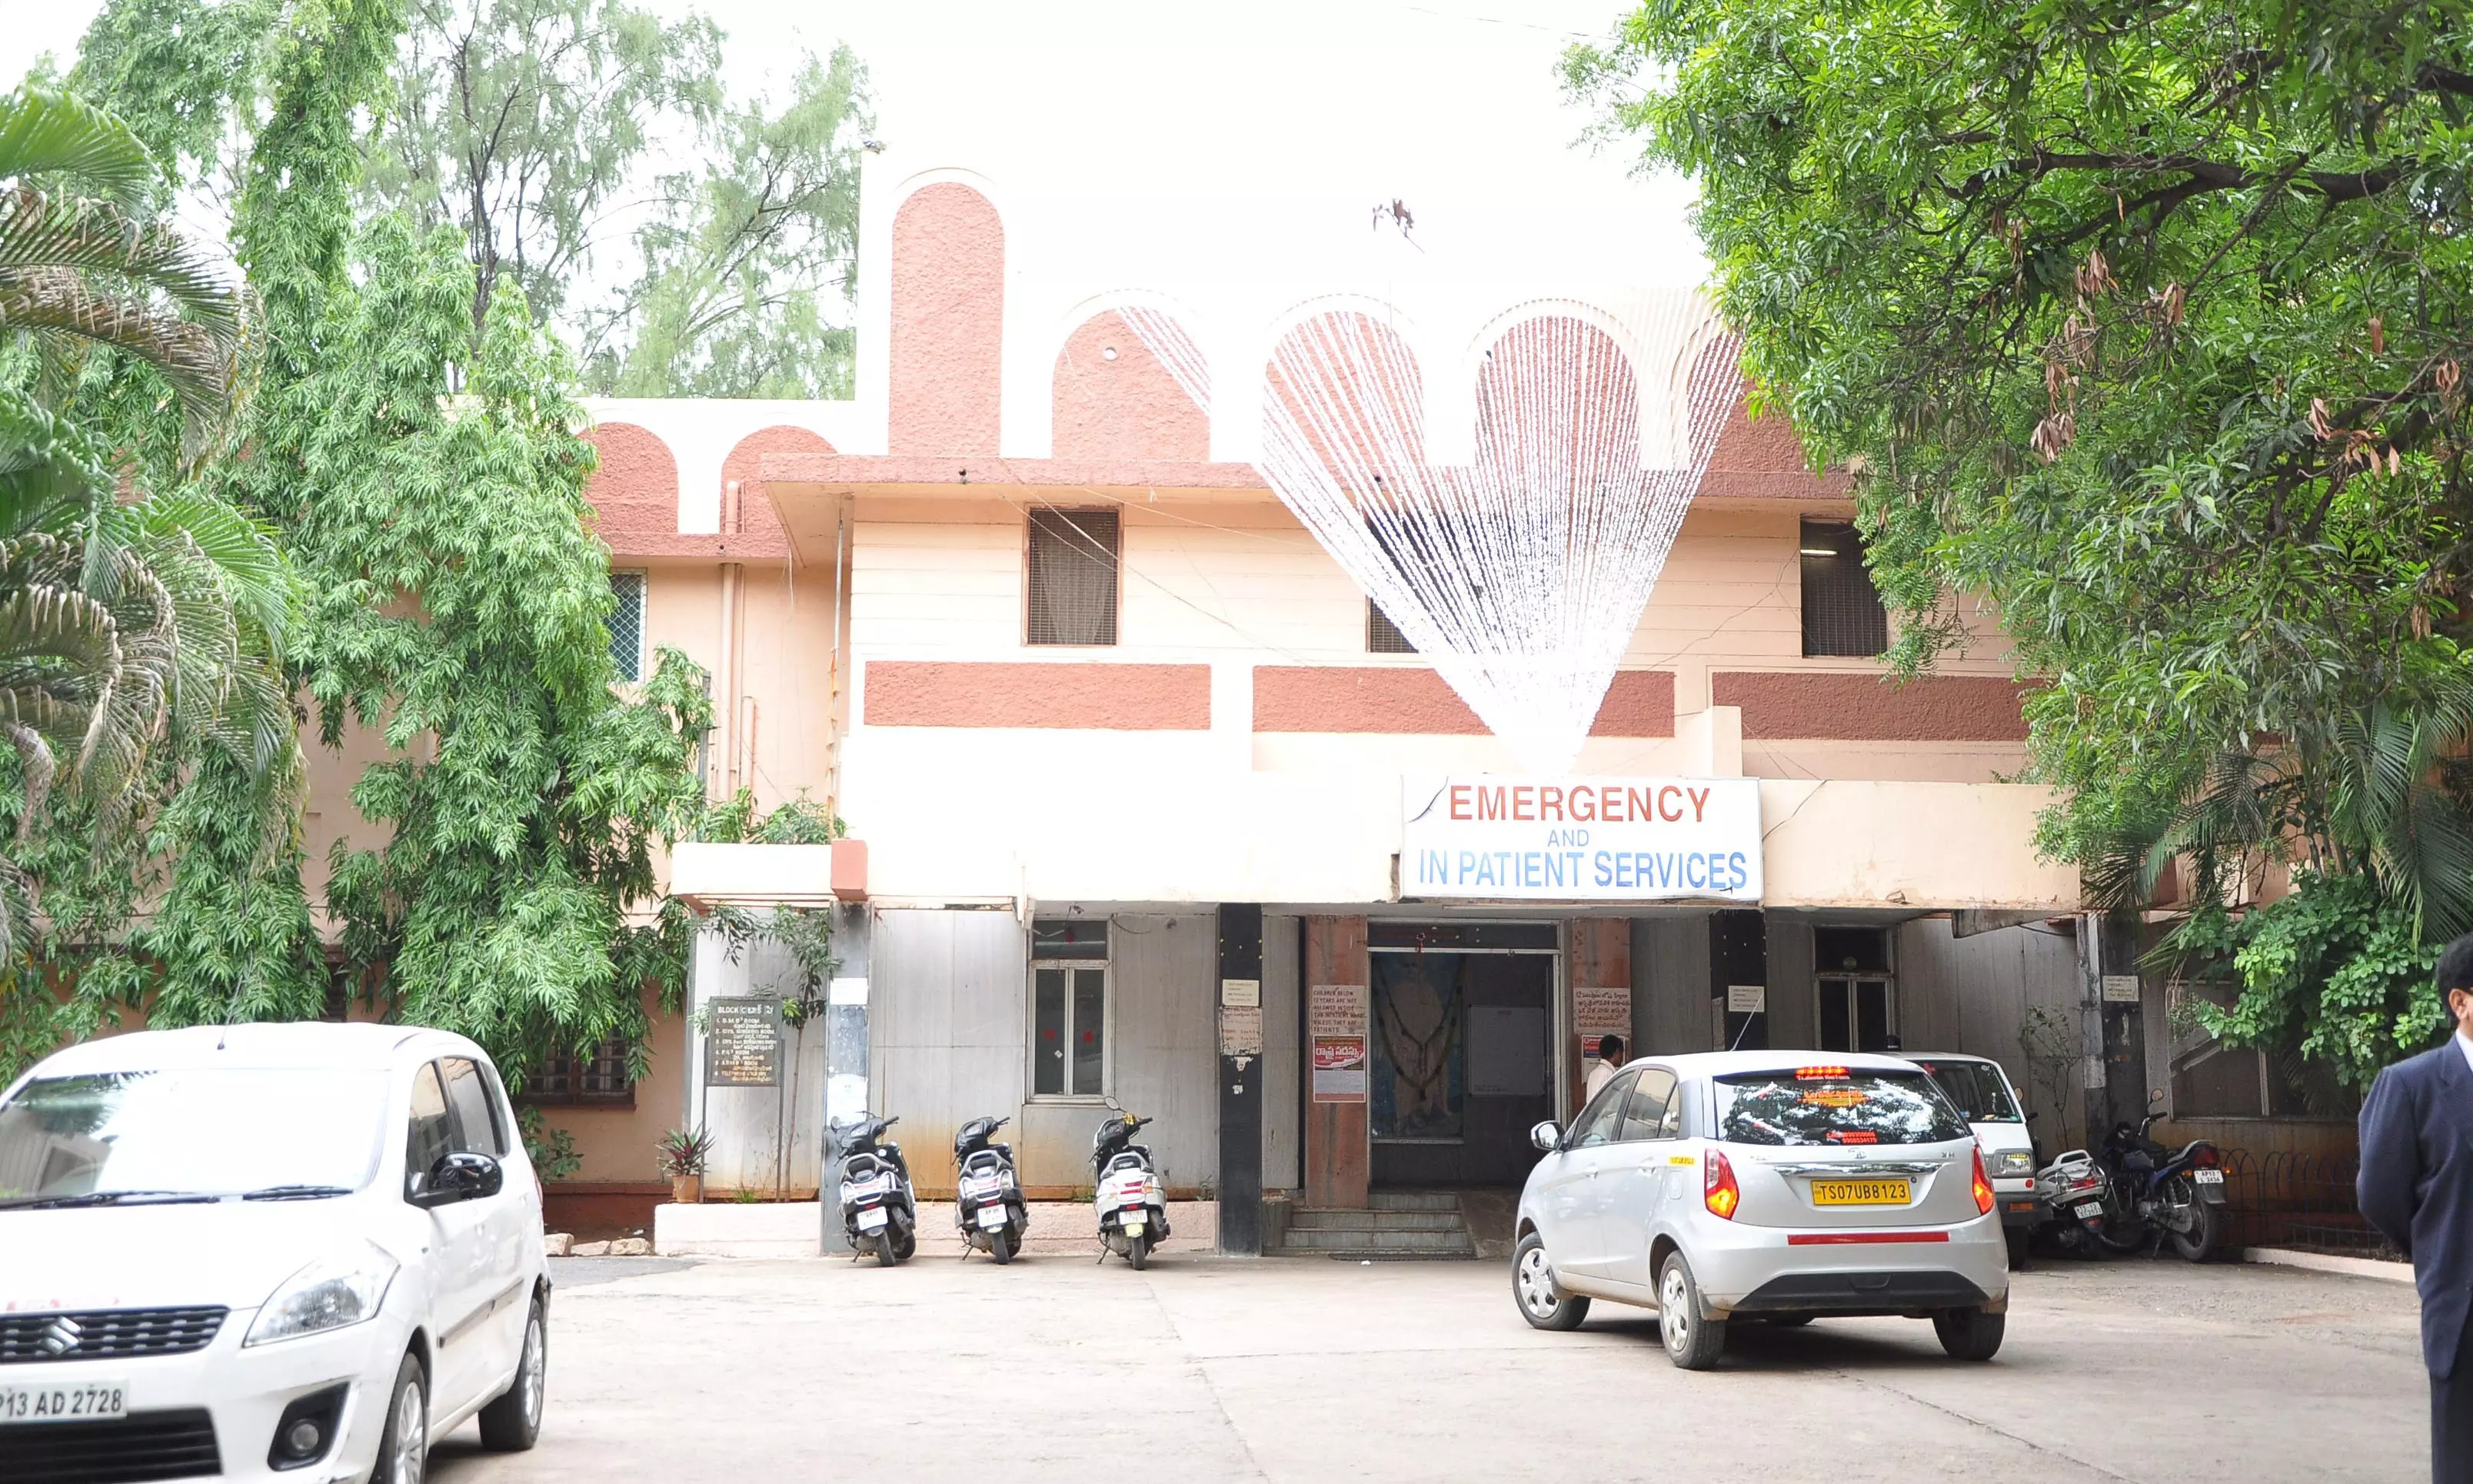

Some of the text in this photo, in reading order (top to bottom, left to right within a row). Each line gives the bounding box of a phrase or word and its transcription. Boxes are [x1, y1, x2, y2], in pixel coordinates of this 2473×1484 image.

[1450, 785, 1710, 823] EMERGENCY
[1548, 829, 1589, 847] AND
[1420, 849, 1747, 890] IN PATIENT SERVICES
[1819, 1185, 1906, 1200] TS07UB8123
[35, 1391, 66, 1416] AD
[72, 1389, 121, 1414] 2728
